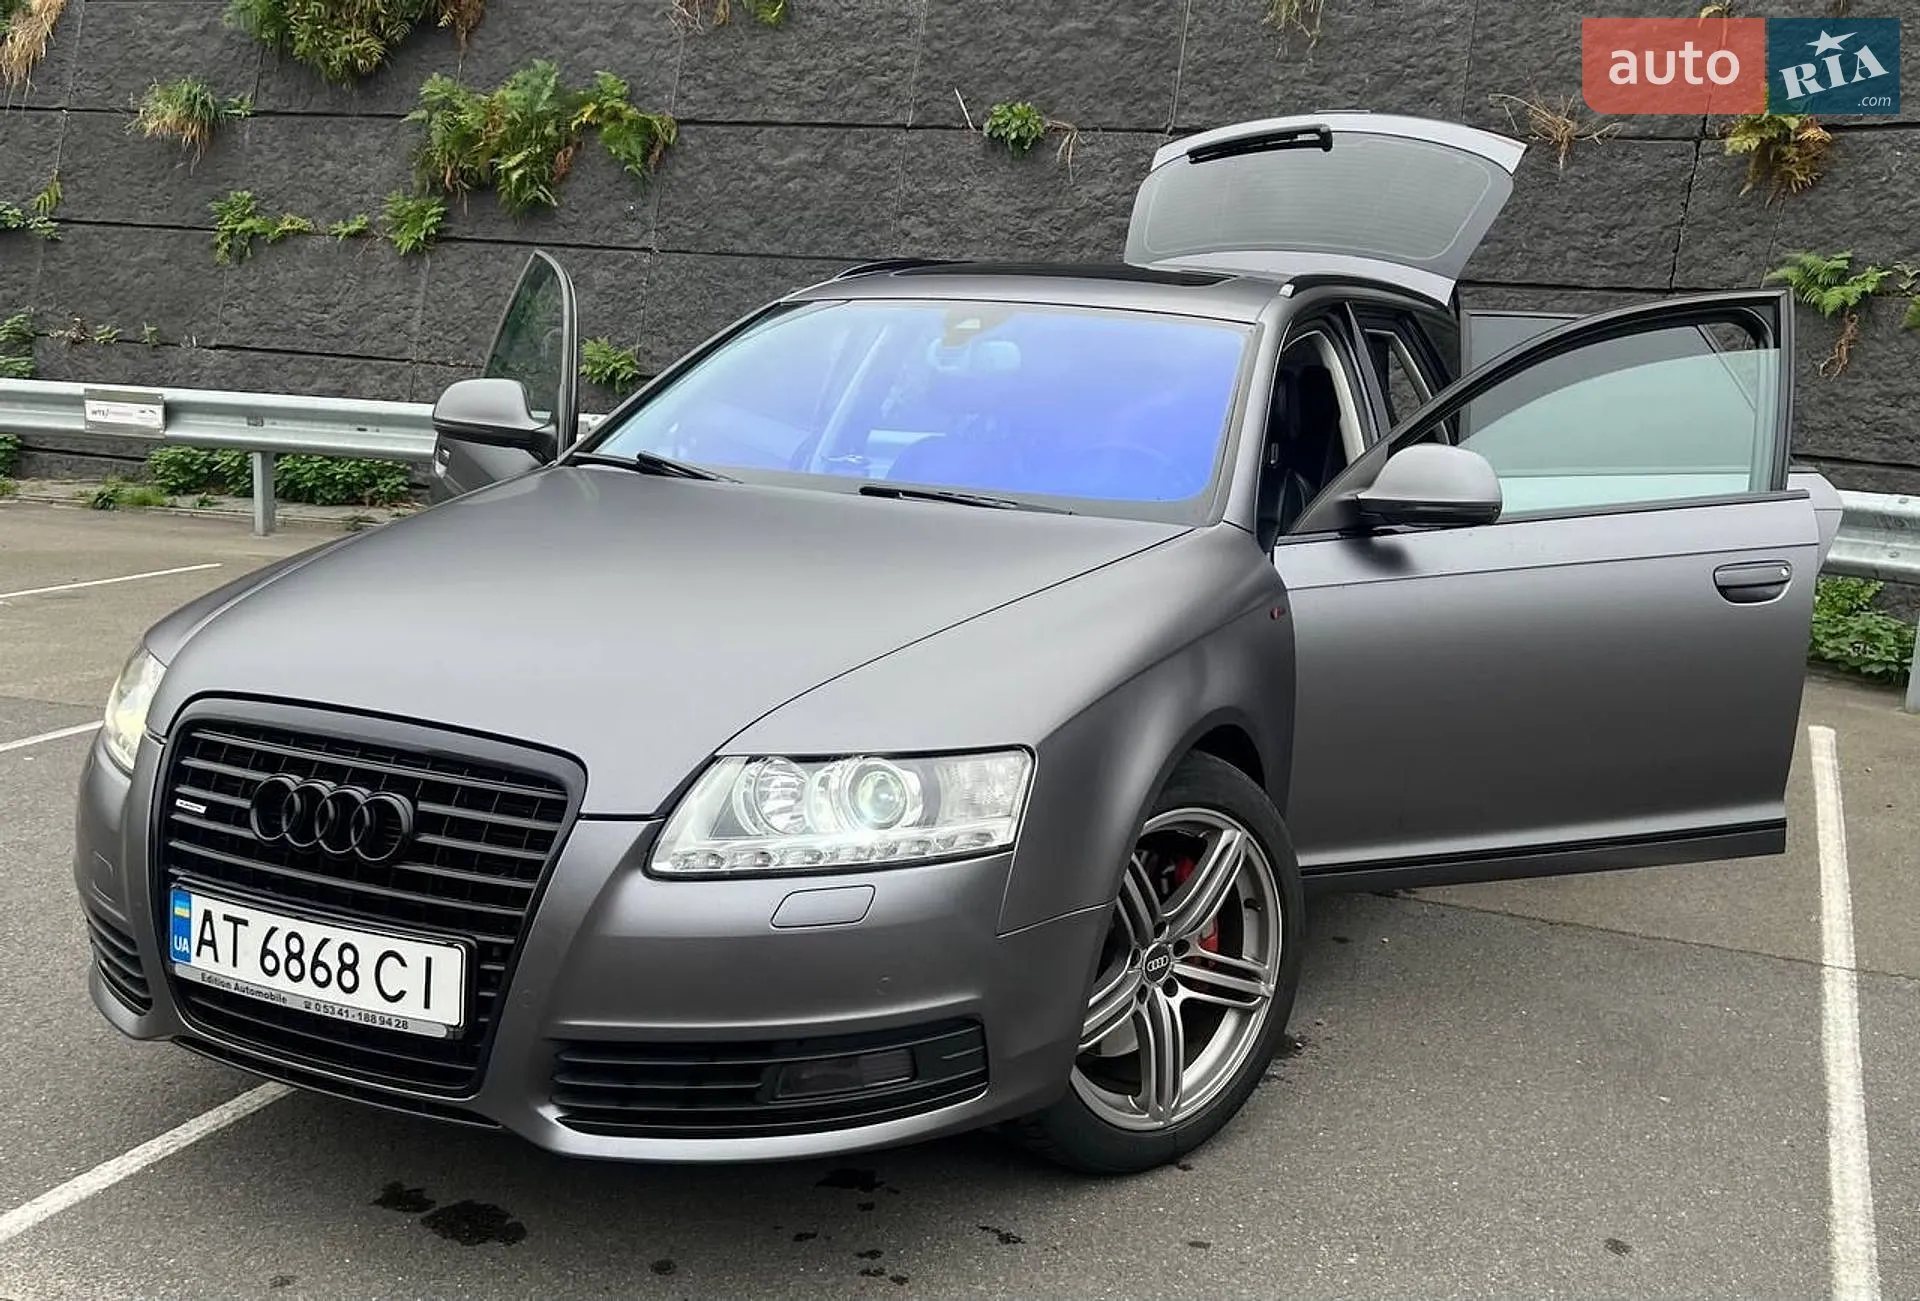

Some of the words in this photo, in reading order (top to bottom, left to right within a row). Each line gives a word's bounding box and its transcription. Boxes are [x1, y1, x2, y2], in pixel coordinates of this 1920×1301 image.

[173, 935, 190, 952] UA
[196, 908, 249, 968] AT
[259, 926, 360, 995] 6868
[374, 949, 432, 1010] CI
